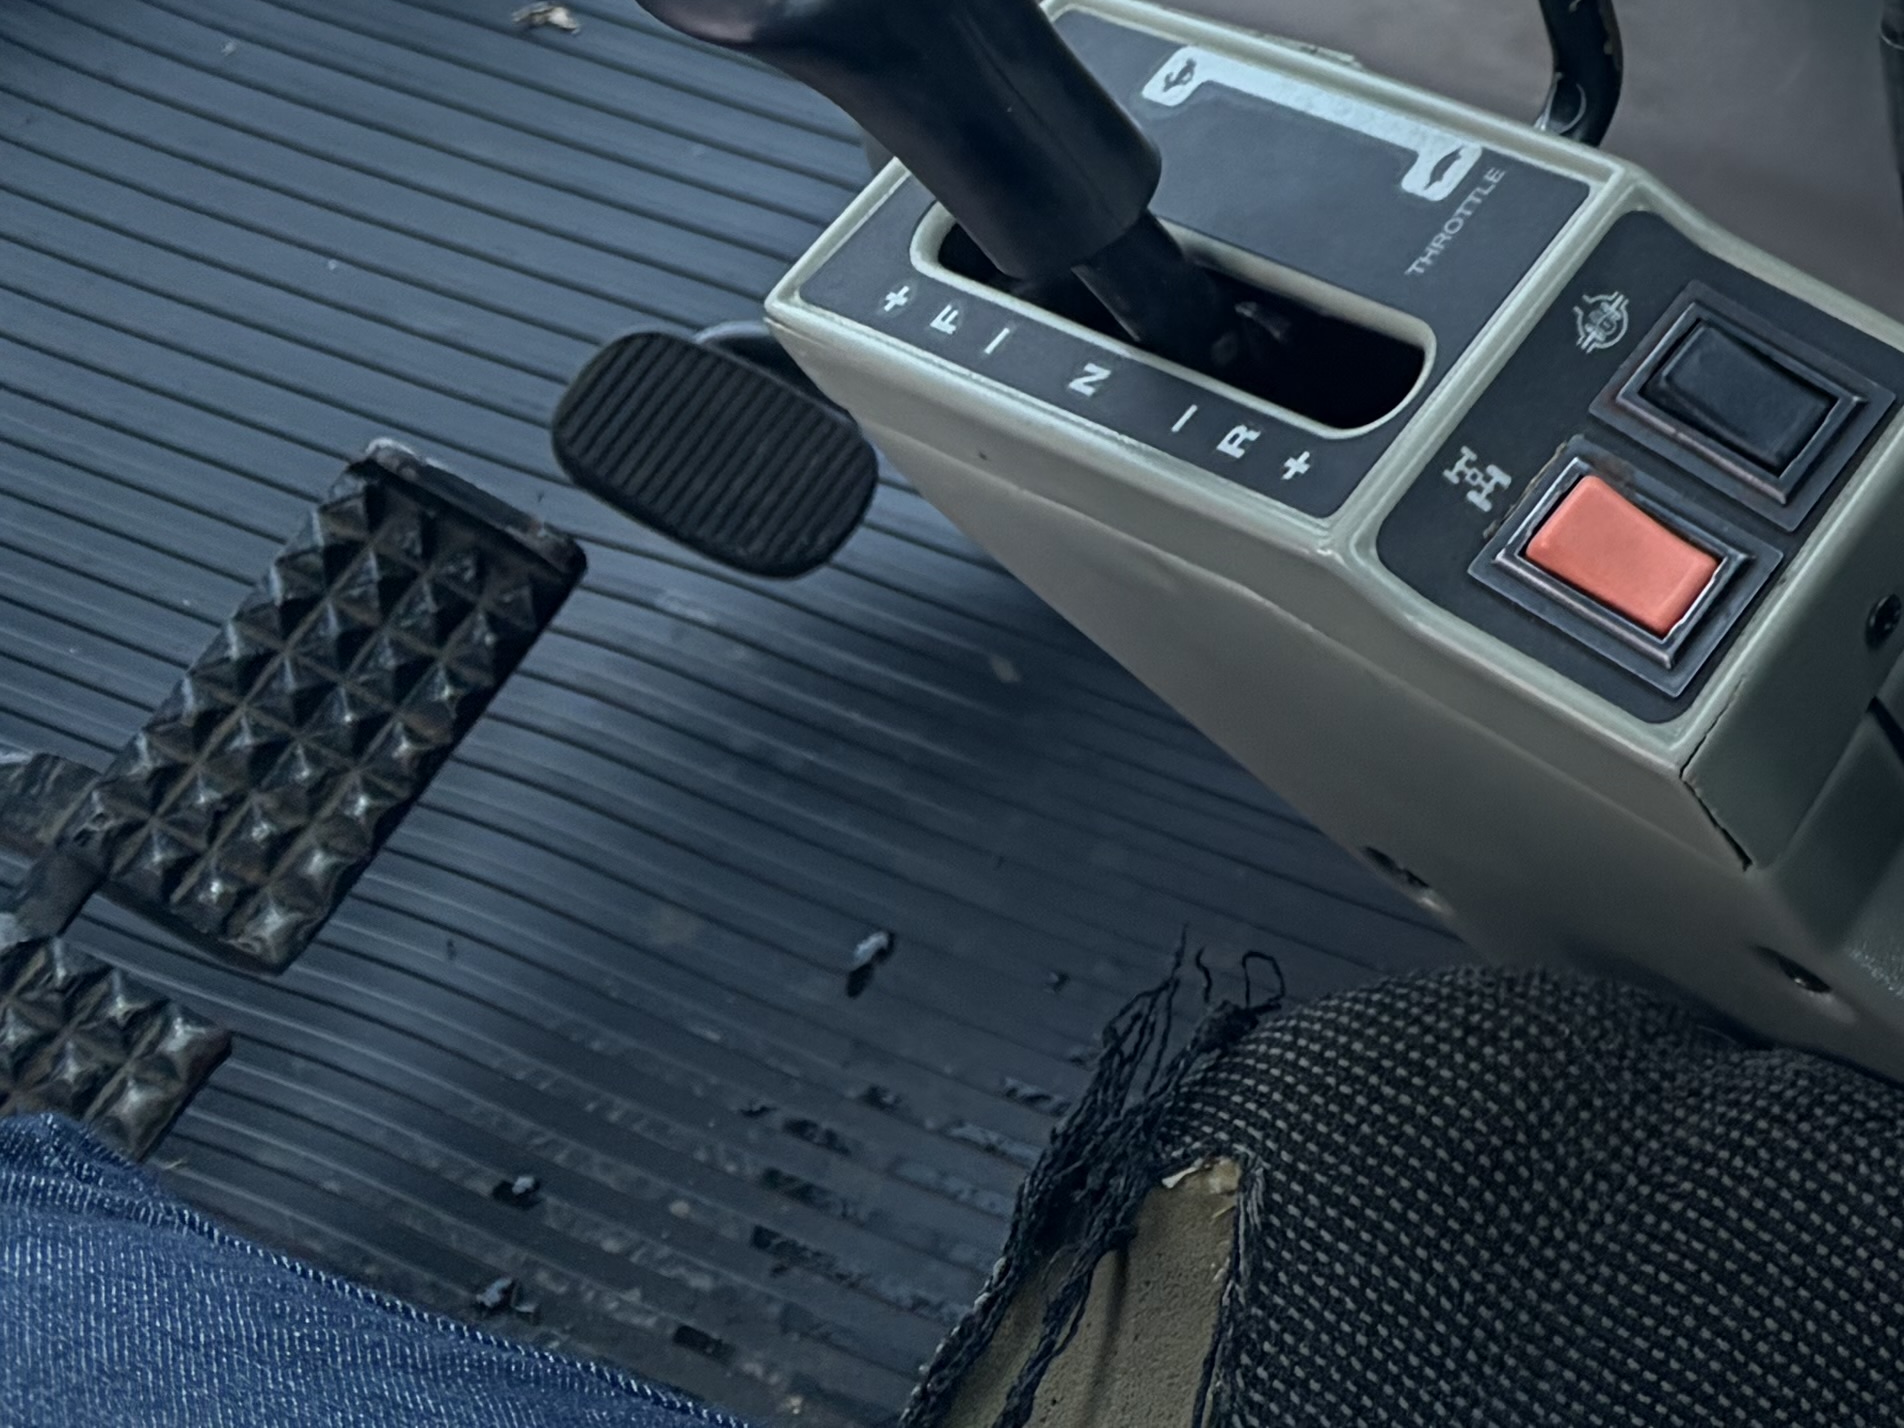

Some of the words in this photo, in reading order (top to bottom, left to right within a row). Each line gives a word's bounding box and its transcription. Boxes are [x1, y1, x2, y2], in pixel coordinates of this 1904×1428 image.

[1404, 167, 1505, 275] THROTTLE
[930, 304, 959, 334] F
[1068, 363, 1111, 397] N
[1216, 424, 1261, 459] R
